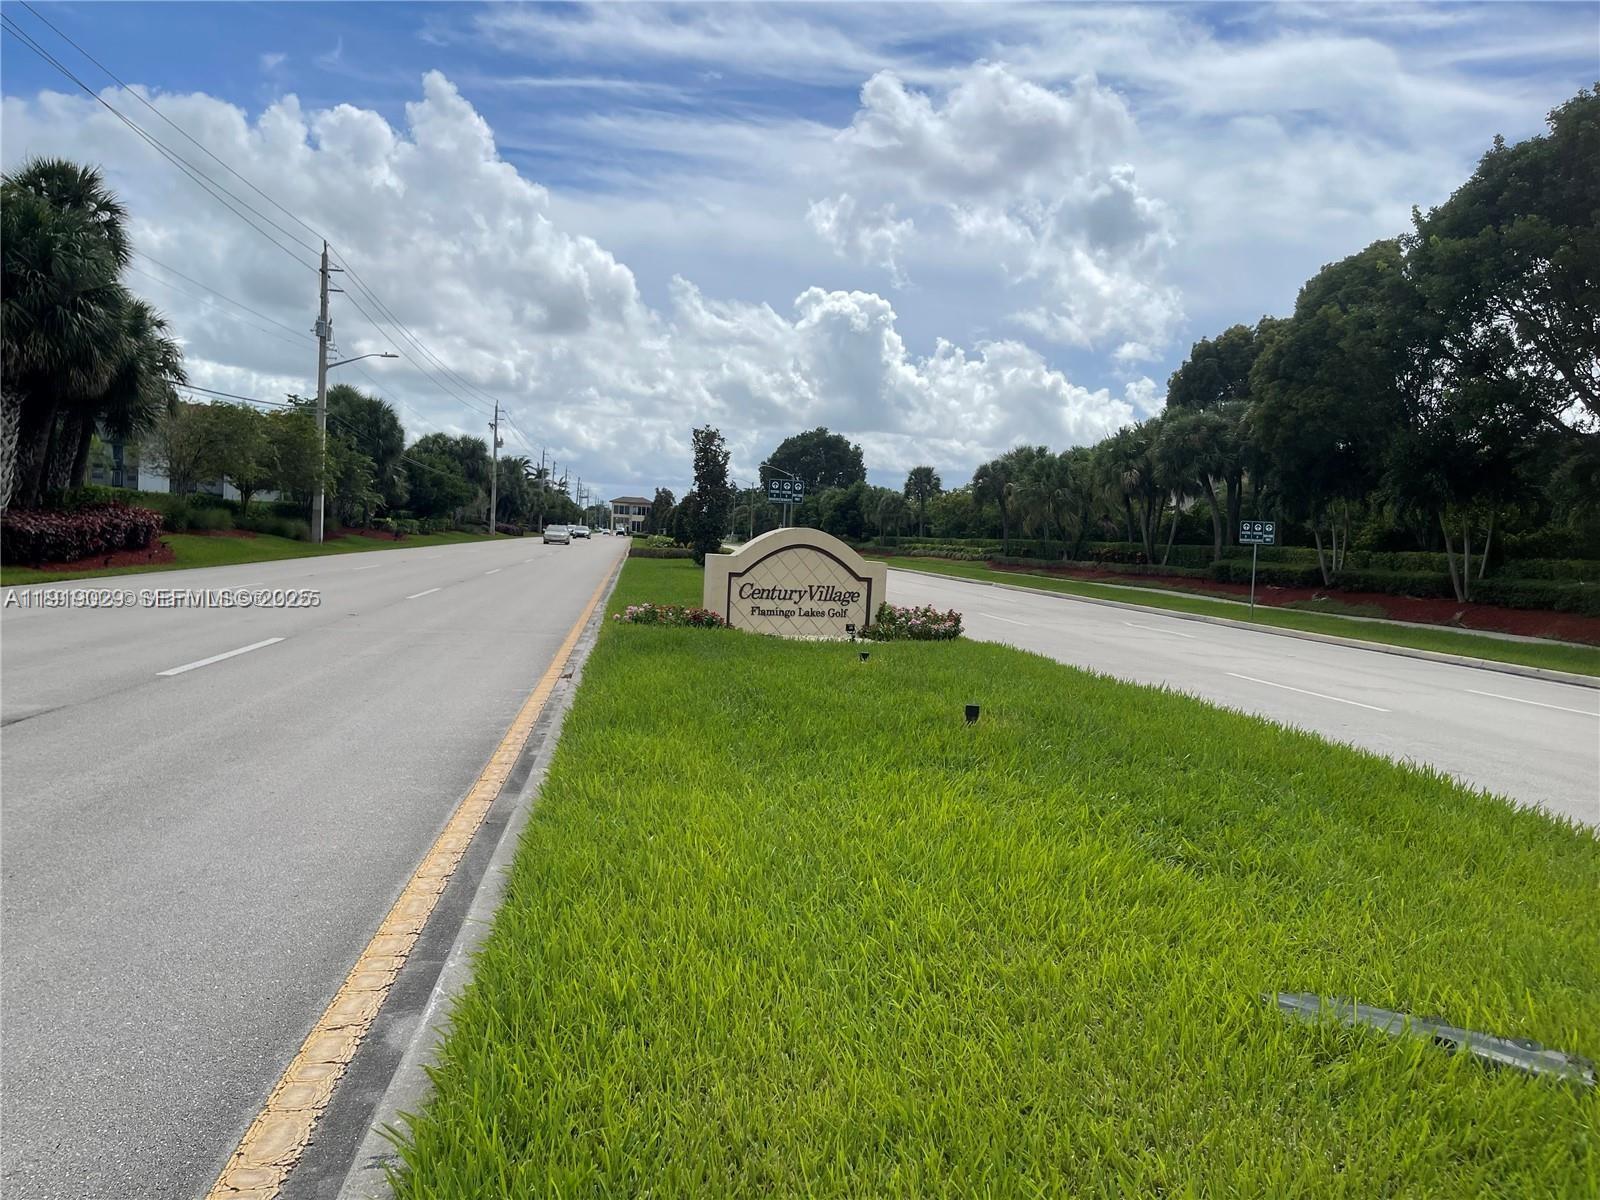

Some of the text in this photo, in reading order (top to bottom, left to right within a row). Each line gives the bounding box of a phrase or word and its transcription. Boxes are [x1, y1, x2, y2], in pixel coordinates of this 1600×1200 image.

[751, 607, 848, 618] Flamingo Lakes Golf
